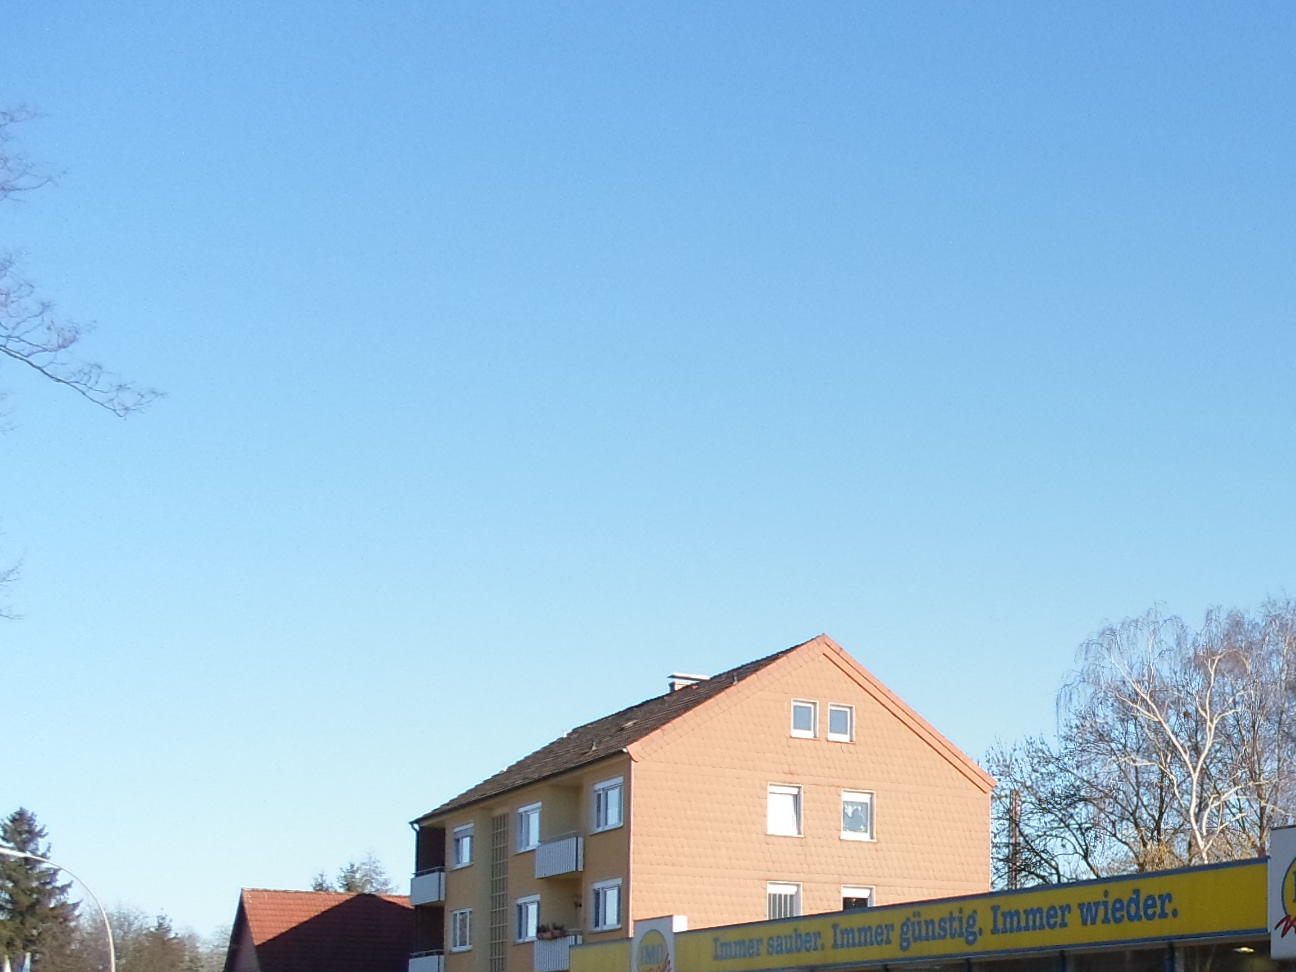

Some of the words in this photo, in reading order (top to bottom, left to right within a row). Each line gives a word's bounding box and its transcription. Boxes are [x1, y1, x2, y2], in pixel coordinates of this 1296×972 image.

[713, 936, 762, 960] Immer
[767, 929, 824, 955] sauber.
[832, 922, 894, 949] Immer
[900, 910, 983, 950] günstig.
[991, 902, 1072, 935] Immer
[1078, 887, 1179, 926] wieder.
